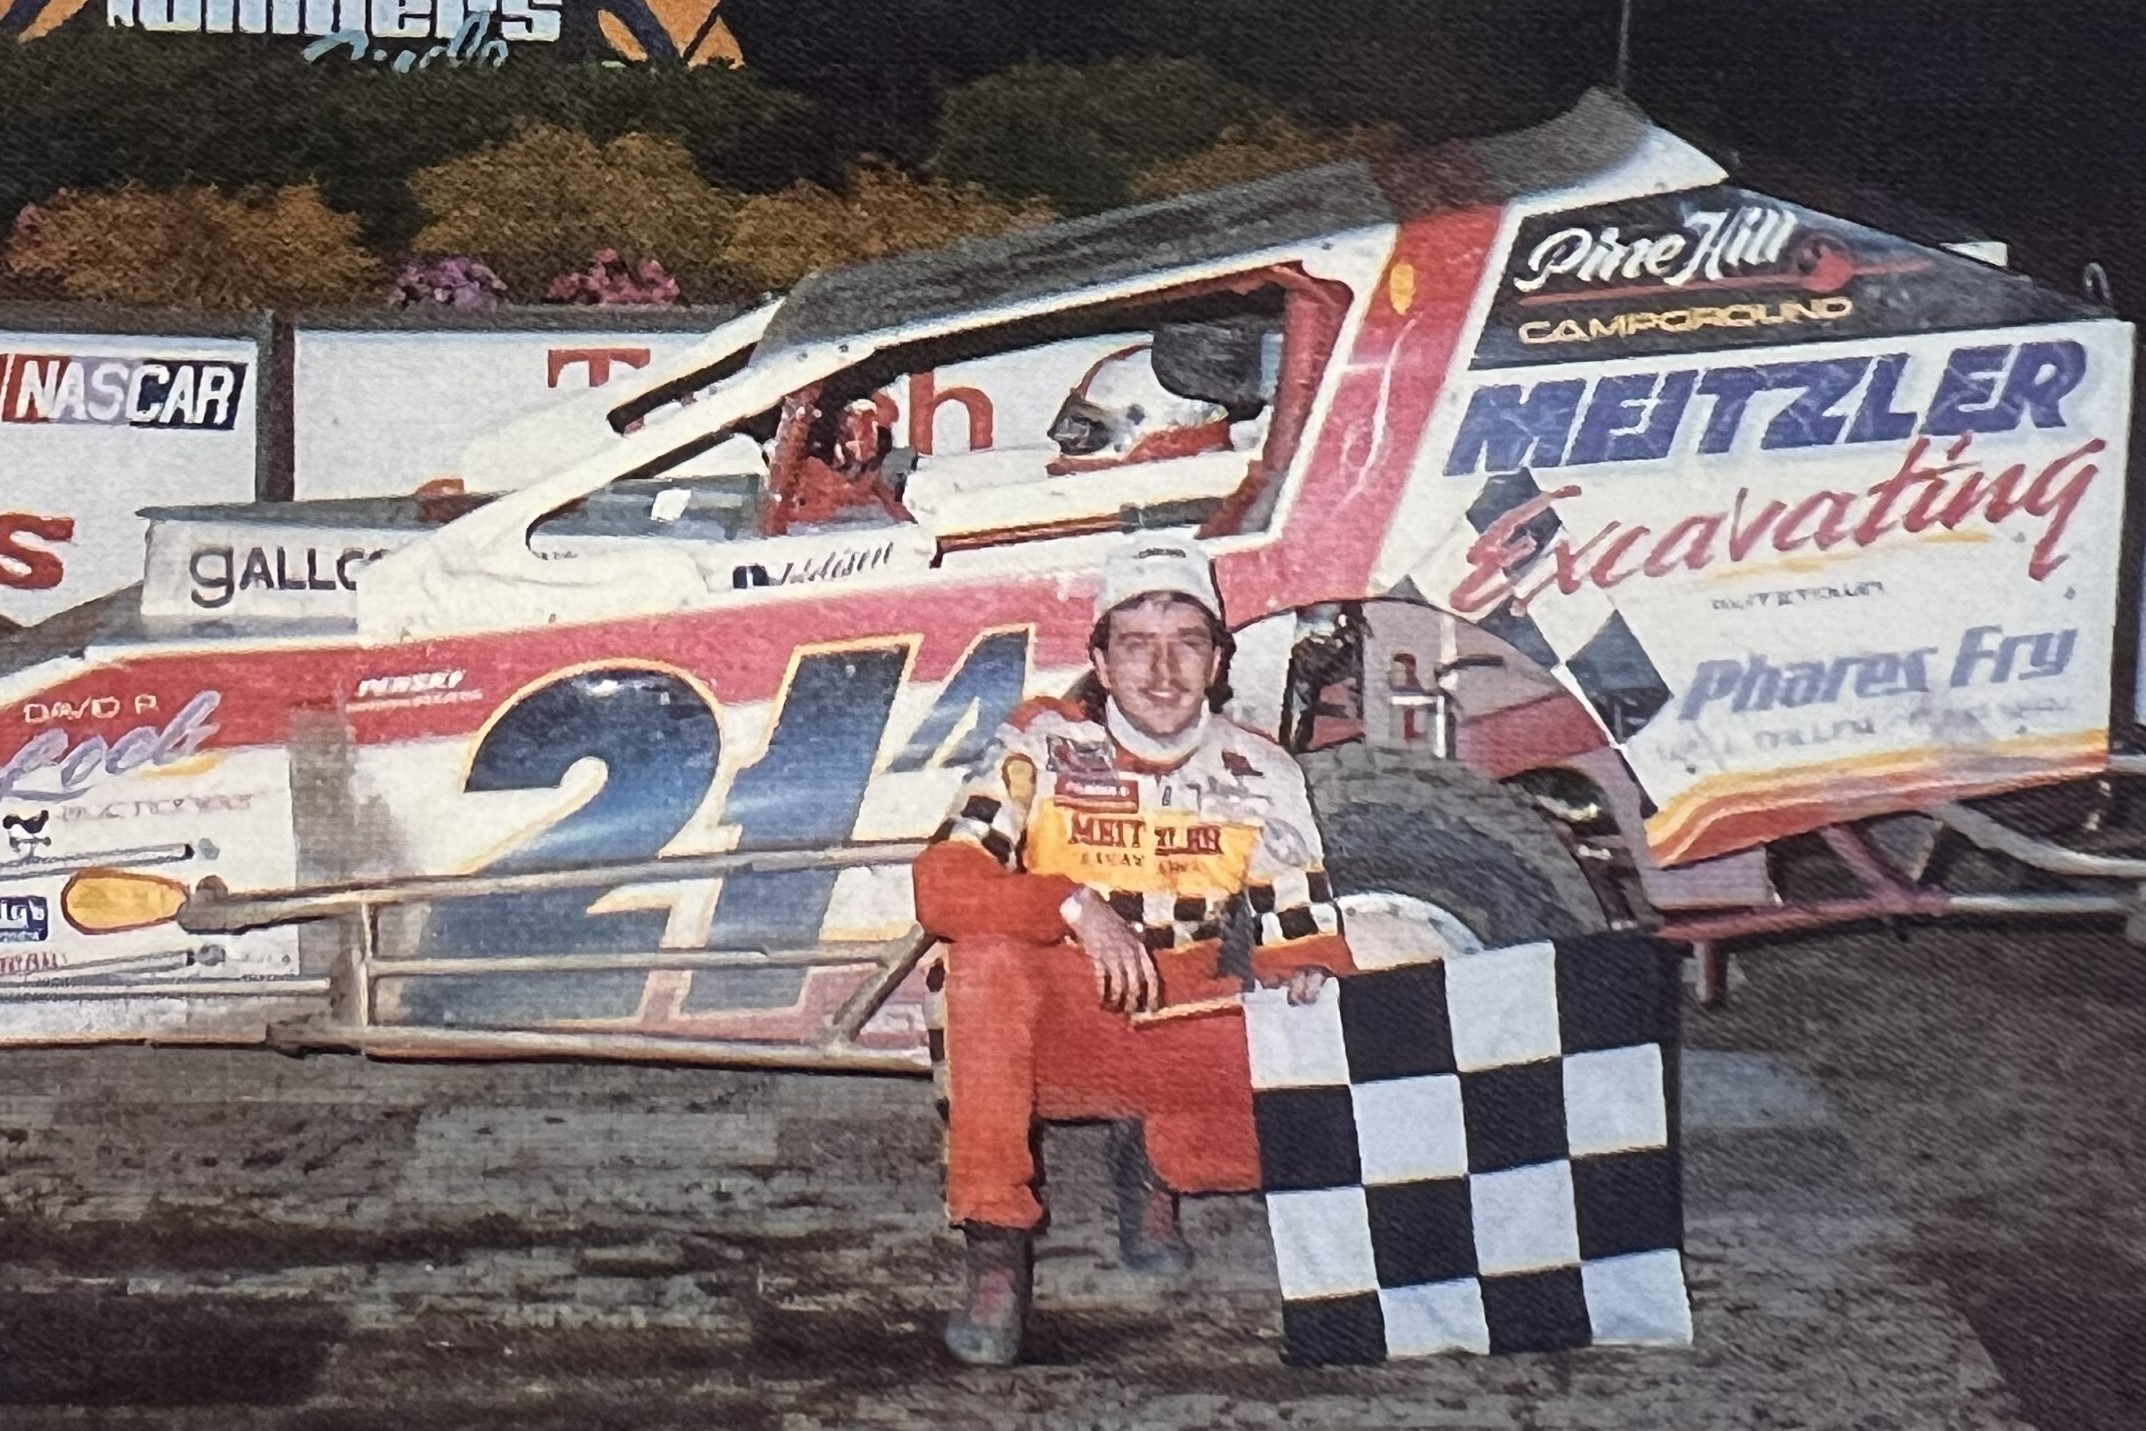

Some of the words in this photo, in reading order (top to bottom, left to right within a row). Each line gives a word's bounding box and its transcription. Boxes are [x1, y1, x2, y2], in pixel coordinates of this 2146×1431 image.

[1513, 226, 1688, 293] Pine
[1663, 205, 1798, 287] Hill
[1518, 295, 1853, 345] CAMPGROUND
[15, 359, 235, 425] NASCAR
[1442, 338, 2089, 477] MEITZLER
[1448, 430, 2107, 614] Excavating
[1949, 624, 2079, 688] Fry
